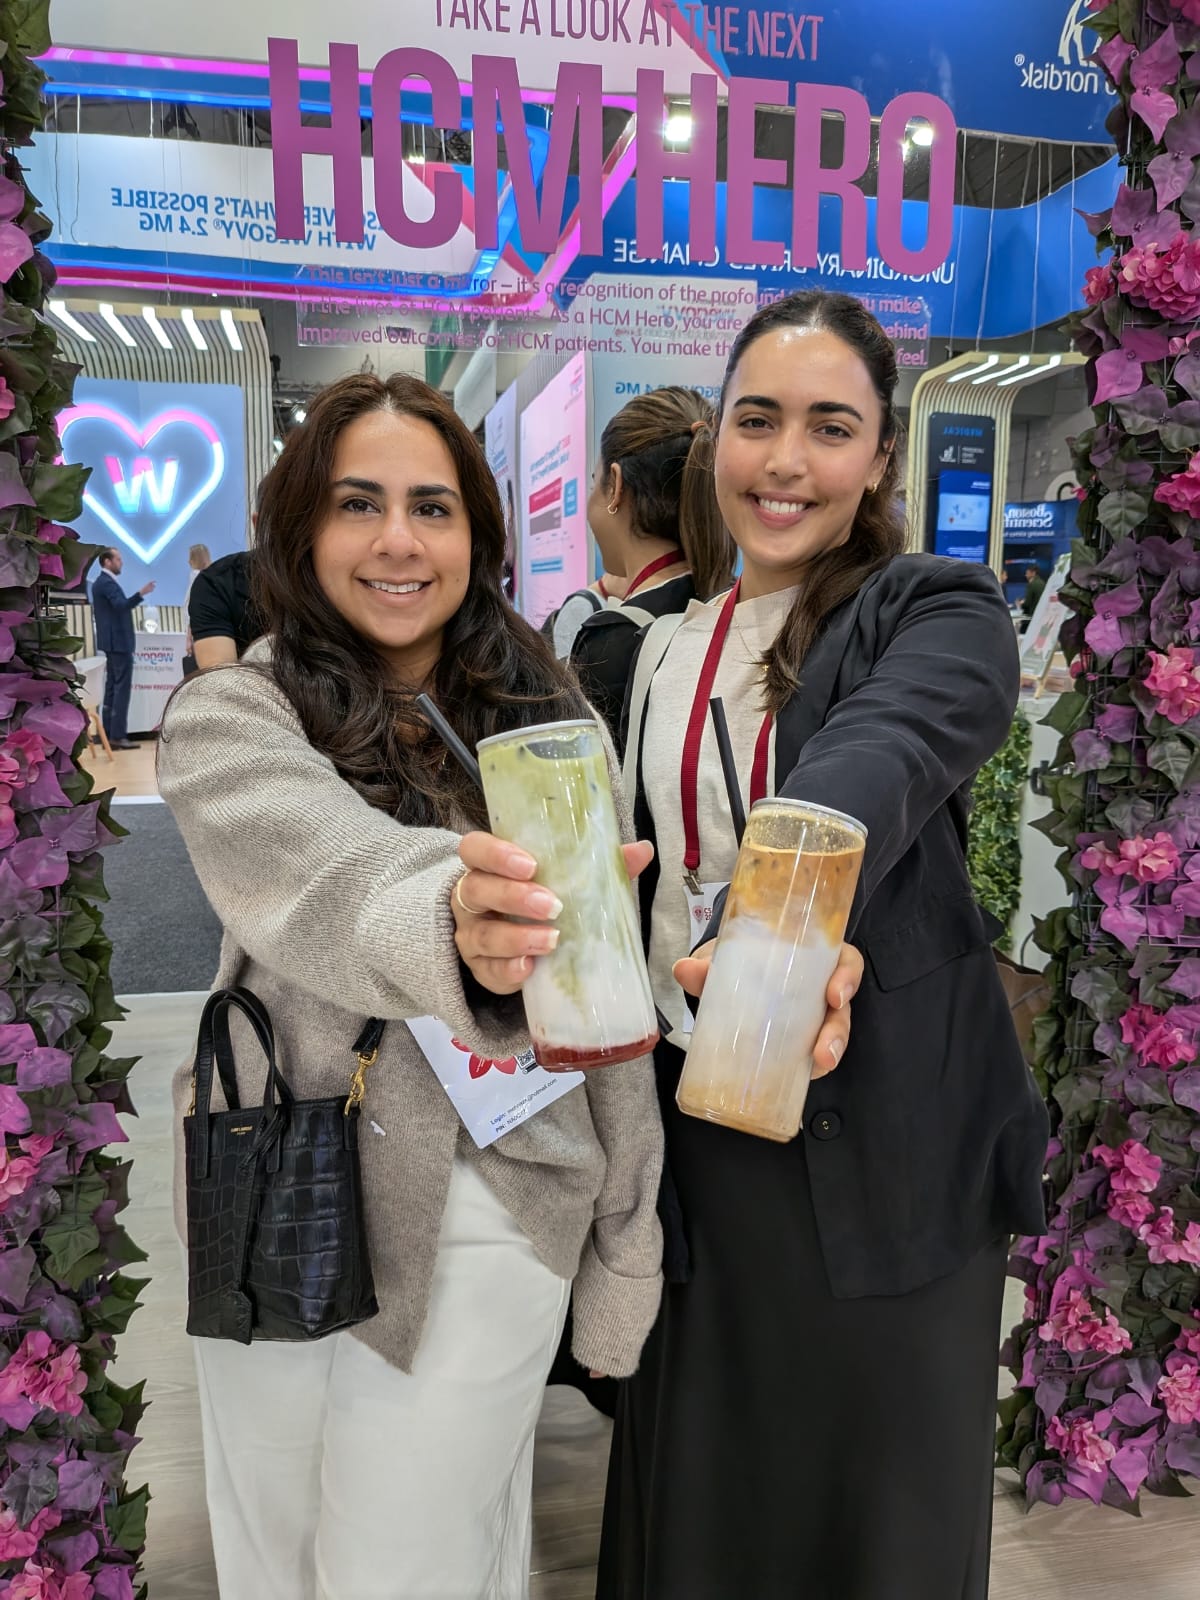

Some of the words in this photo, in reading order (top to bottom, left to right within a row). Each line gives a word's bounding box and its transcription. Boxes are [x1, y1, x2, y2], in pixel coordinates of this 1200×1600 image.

[435, 0, 511, 33] TAKE
[519, 0, 541, 35] A
[550, 0, 631, 44] LOOK
[638, 1, 676, 47] AT
[684, 3, 739, 56] THE
[748, 10, 823, 62] NEXT
[267, 36, 604, 257] HCM
[635, 66, 957, 276] HERO
[307, 266, 344, 284] This
[351, 268, 385, 286] isn't
[391, 271, 423, 290] just
[428, 276, 440, 289] a
[559, 281, 654, 303] recognition
[658, 283, 677, 300] of
[680, 285, 707, 303] the
[320, 298, 350, 315] the
[355, 299, 394, 317] lives
[396, 301, 416, 317] of
[550, 308, 570, 325] As
[574, 312, 585, 324] a
[589, 308, 630, 327] HCM
[635, 310, 679, 330] Hero,
[682, 313, 713, 333] you
[716, 317, 743, 331] are
[879, 296, 922, 315] make
[298, 324, 383, 346] improved
[387, 327, 473, 347] outcomes
[478, 329, 501, 348] for
[508, 331, 551, 351] HCM
[554, 336, 627, 355] patients.
[630, 336, 662, 355] You
[666, 339, 712, 356] make
[882, 320, 929, 341] ehind
[895, 346, 929, 367] feel.
[104, 455, 178, 514] W
